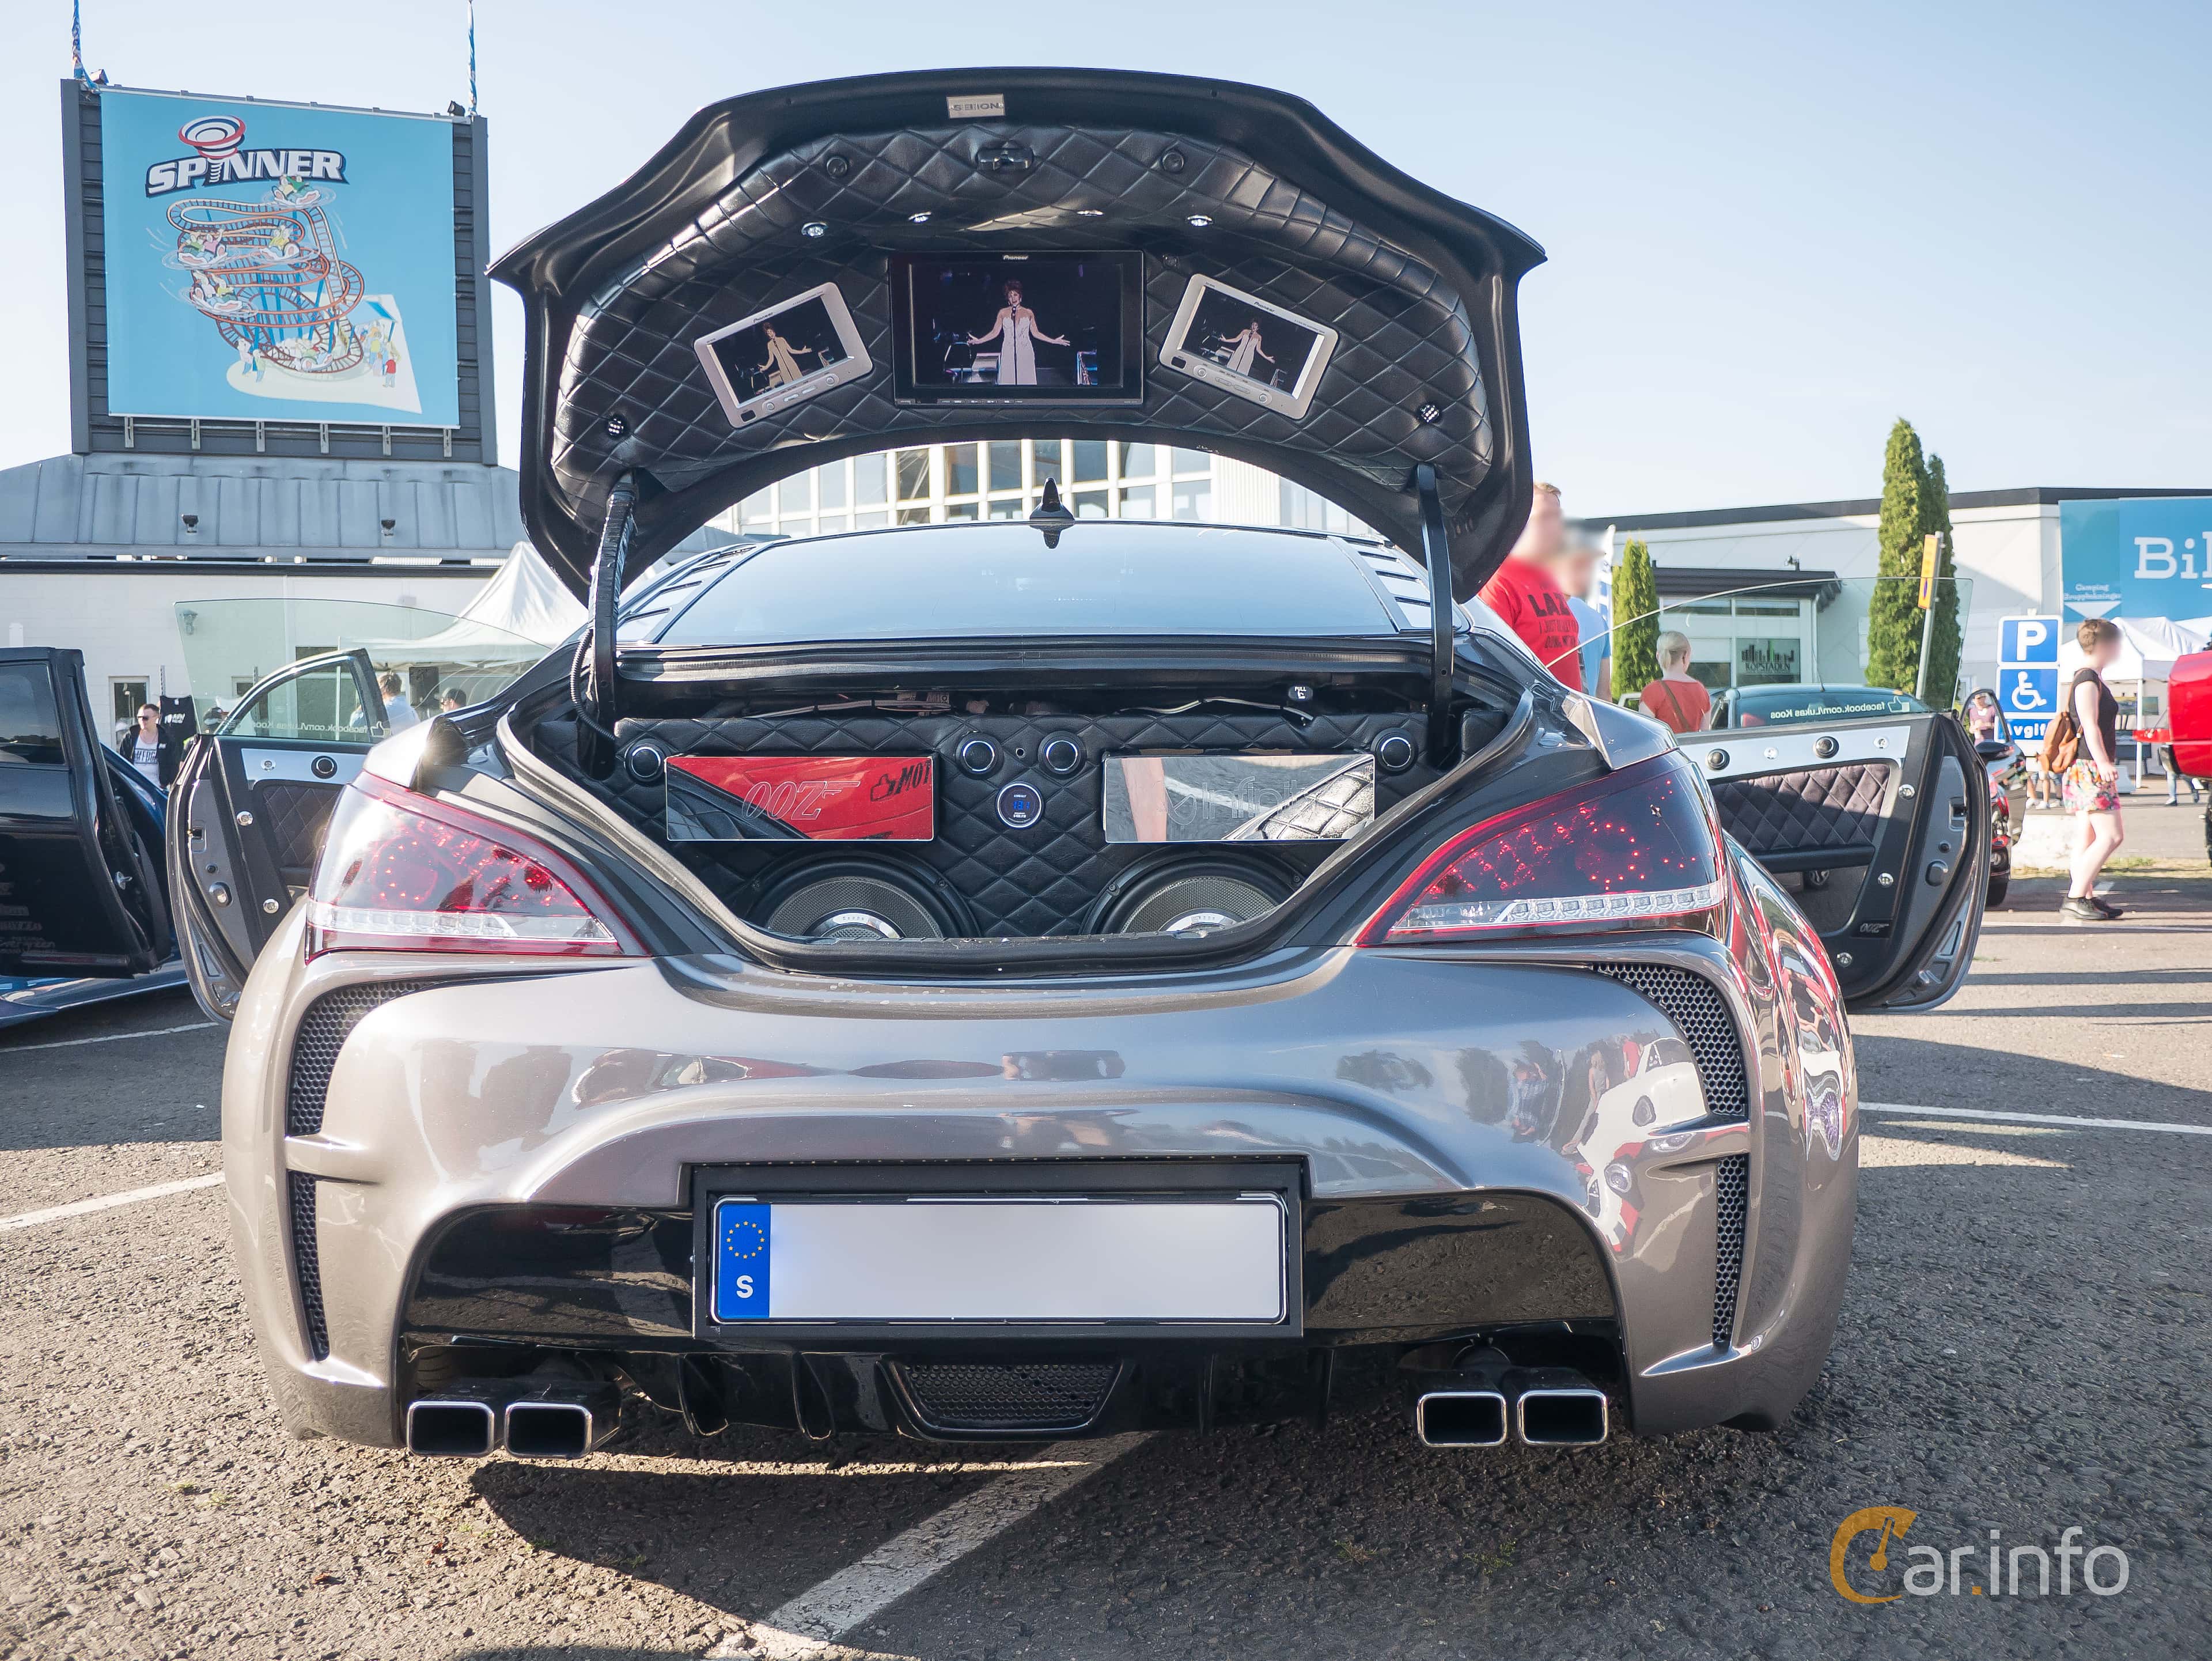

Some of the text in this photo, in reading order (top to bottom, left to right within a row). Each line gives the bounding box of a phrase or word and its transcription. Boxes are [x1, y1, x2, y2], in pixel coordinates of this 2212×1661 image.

[147, 149, 347, 197] SPINNER
[2016, 621, 2047, 661] P
[736, 1274, 753, 1299] S
